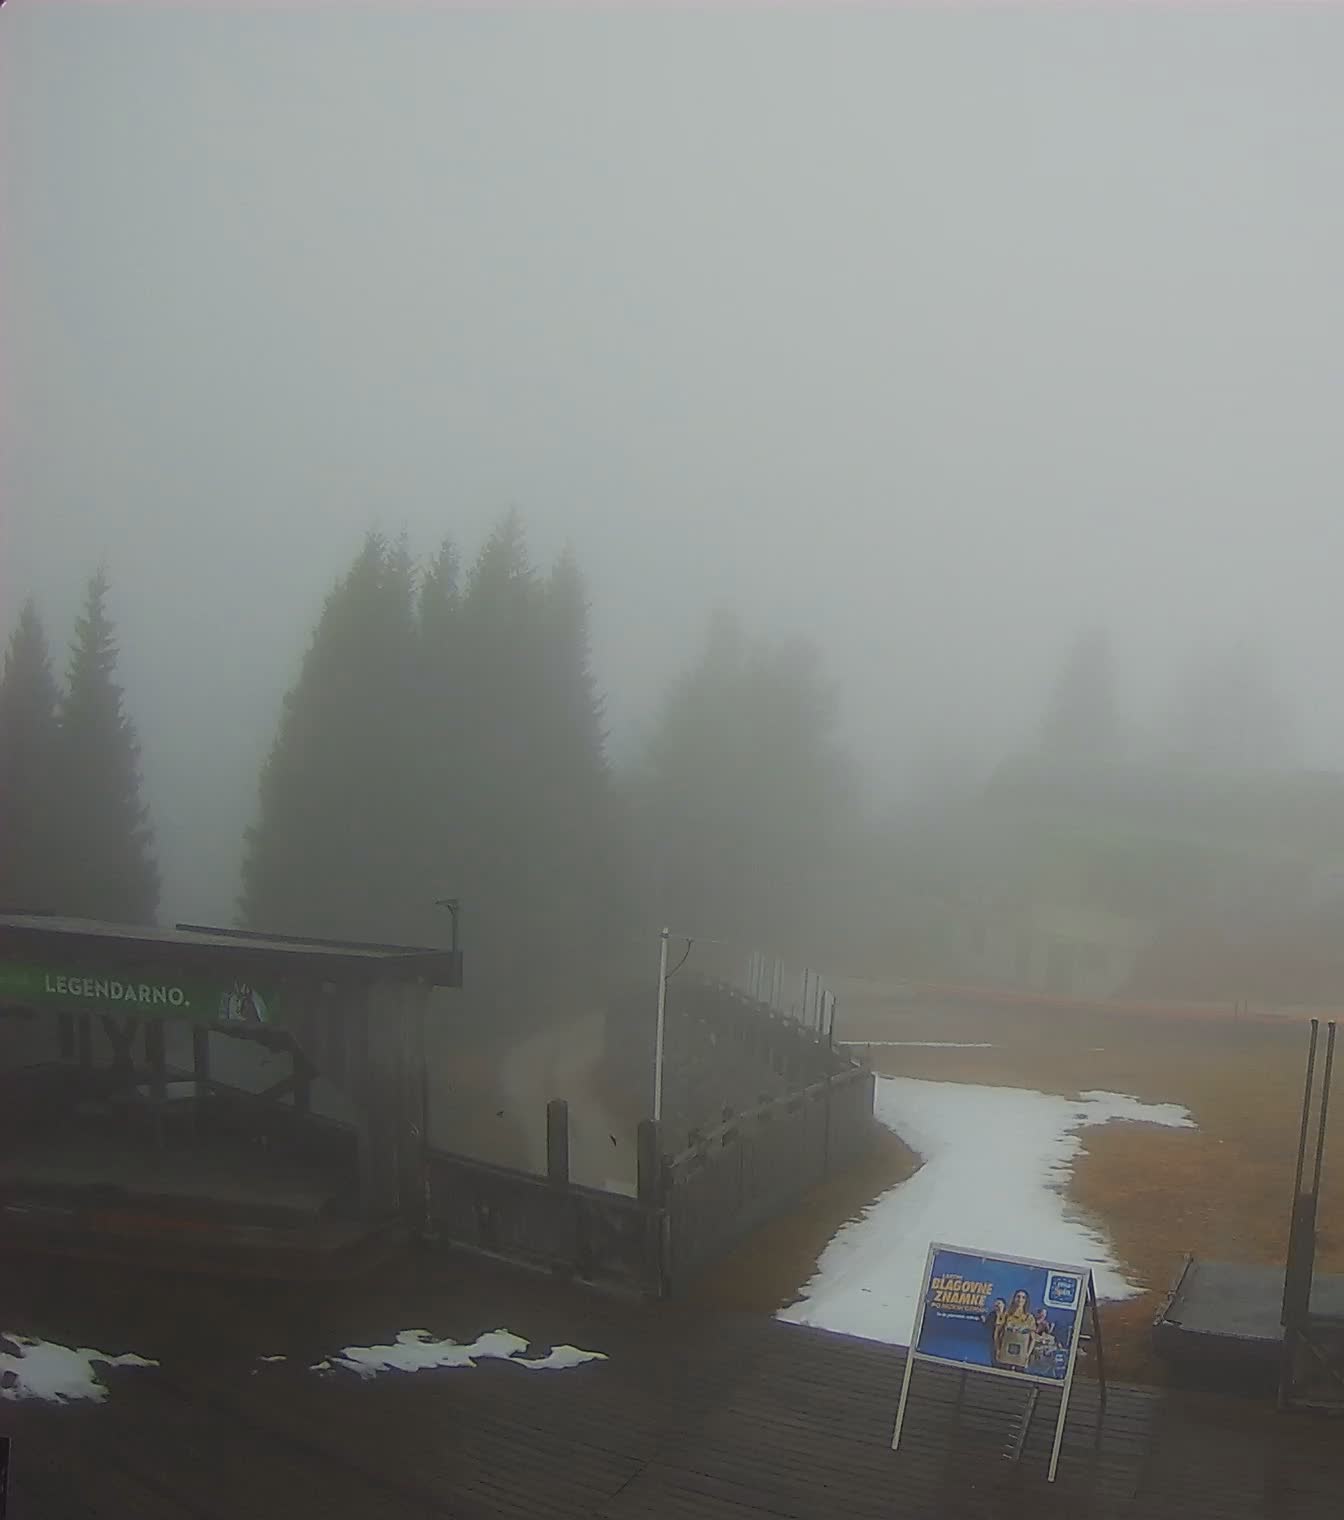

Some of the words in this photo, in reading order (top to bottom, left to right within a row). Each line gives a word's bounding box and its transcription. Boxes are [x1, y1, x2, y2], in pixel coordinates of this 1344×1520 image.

[45, 974, 191, 1008] LEGENDARNO.
[931, 1277, 993, 1296] BLAGOVNE
[933, 1290, 987, 1306] ZNAMKE
